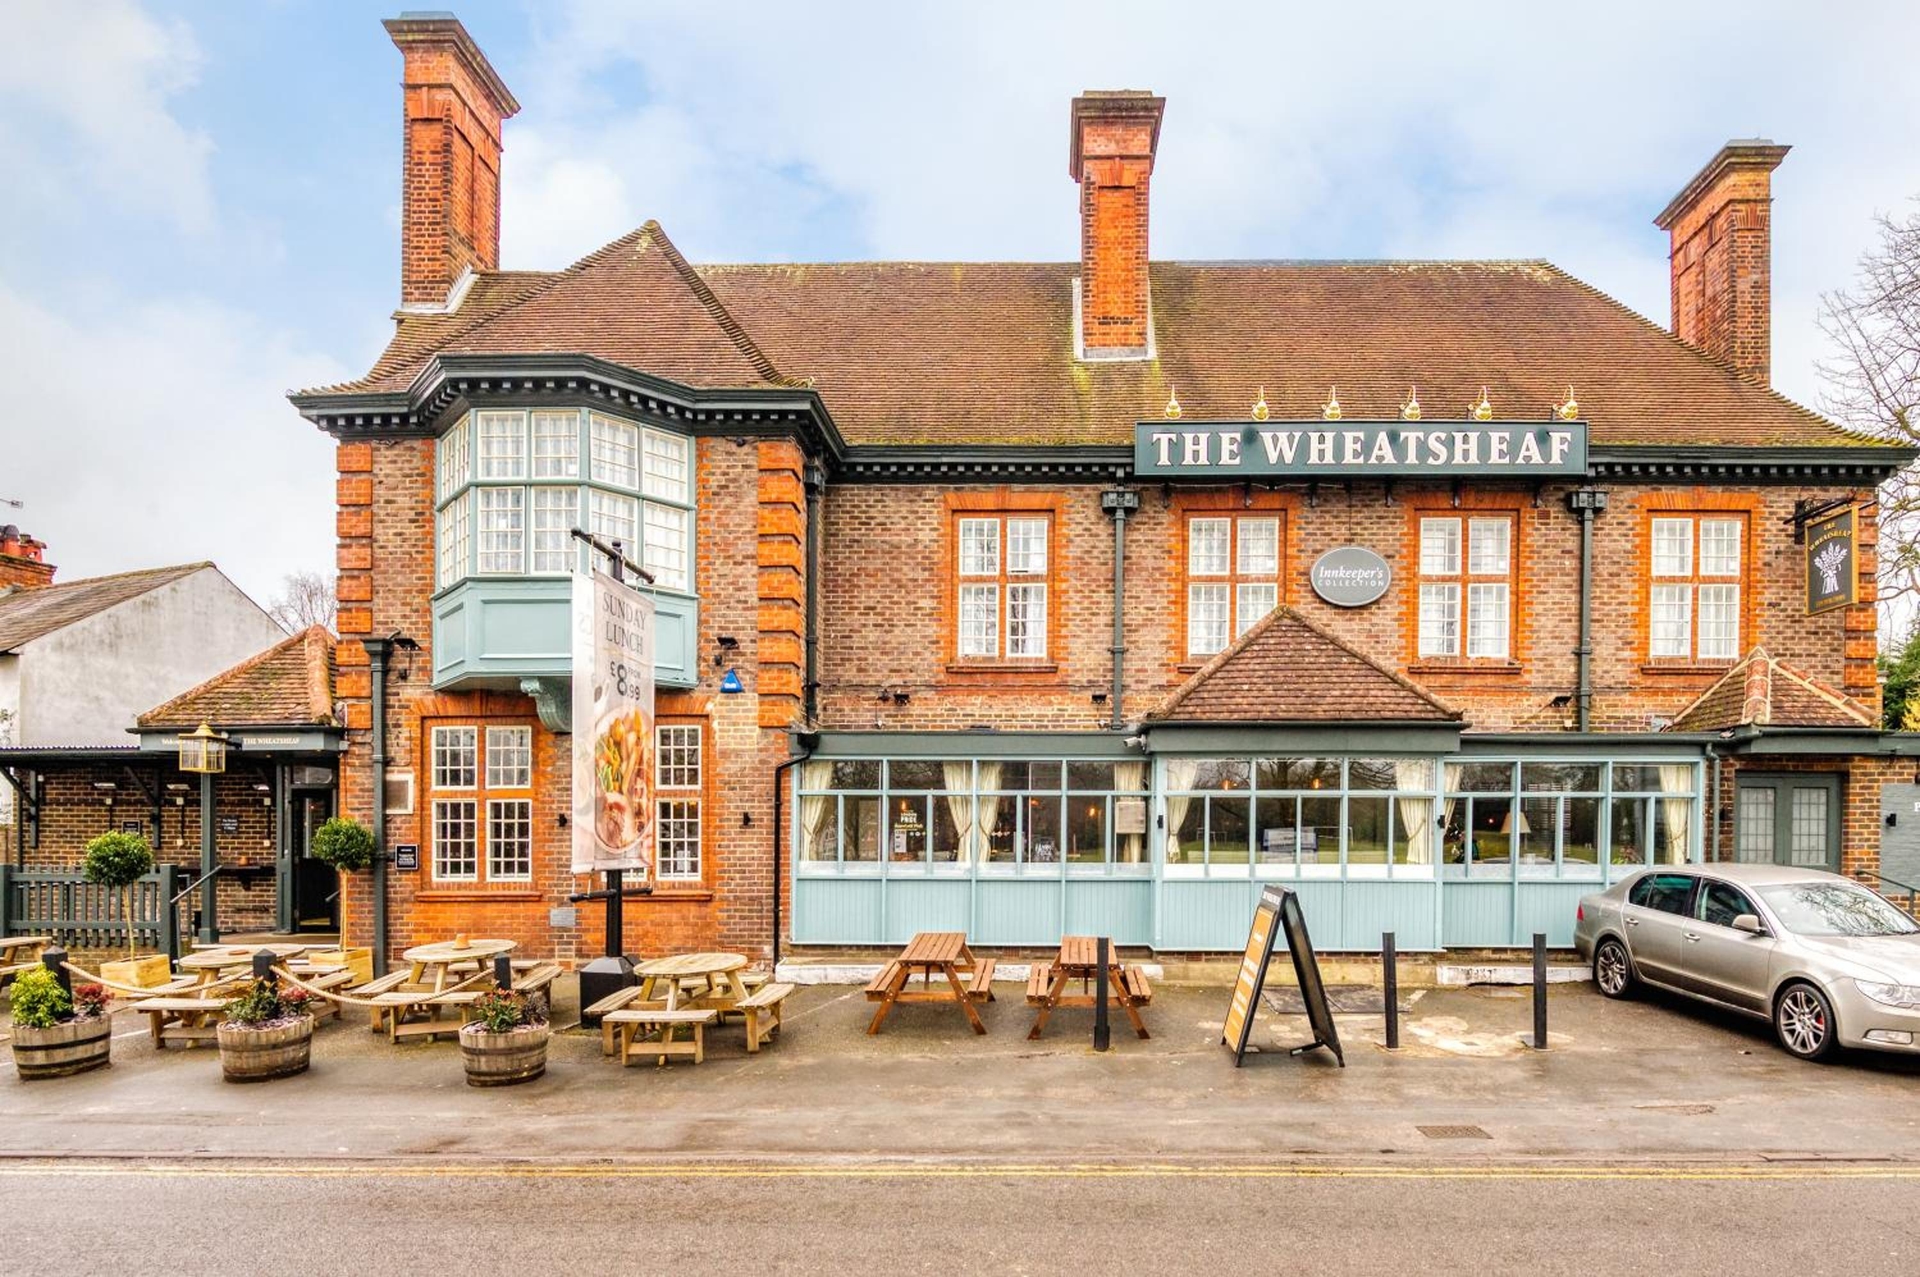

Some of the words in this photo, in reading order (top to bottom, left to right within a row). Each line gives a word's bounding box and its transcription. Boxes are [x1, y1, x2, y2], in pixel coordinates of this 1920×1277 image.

[1151, 431, 1241, 466] THE
[1258, 430, 1571, 466] WHEATSHEAF
[1319, 566, 1383, 581] Innkeeper's
[602, 591, 646, 630] SUNDAY
[606, 621, 643, 655] LUNCH
[243, 737, 257, 745] THE
[258, 737, 300, 745] WHEATSHEAF
